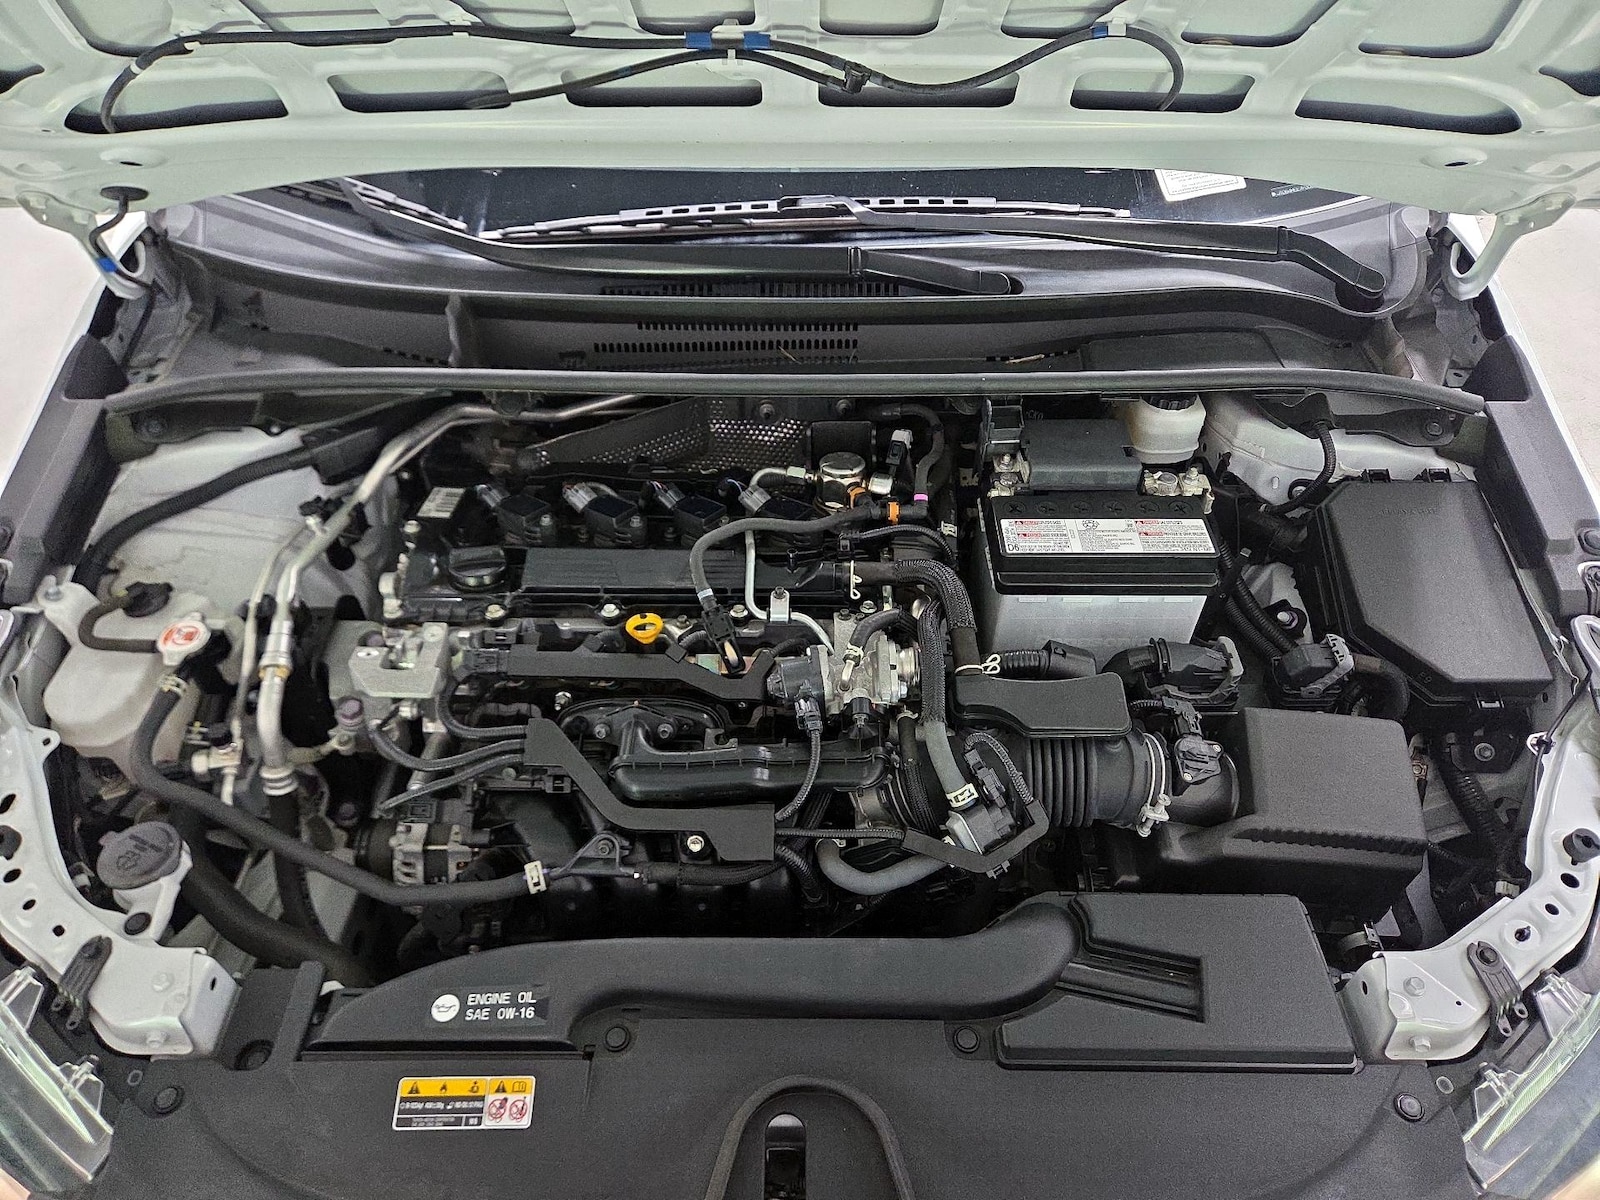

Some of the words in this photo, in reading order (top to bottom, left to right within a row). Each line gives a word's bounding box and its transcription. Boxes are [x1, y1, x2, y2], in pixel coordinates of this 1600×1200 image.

[466, 992, 511, 1006] ENGINE
[517, 991, 537, 1004] OIL
[464, 1008, 491, 1021] SAE
[496, 1006, 535, 1020] 0W-16
